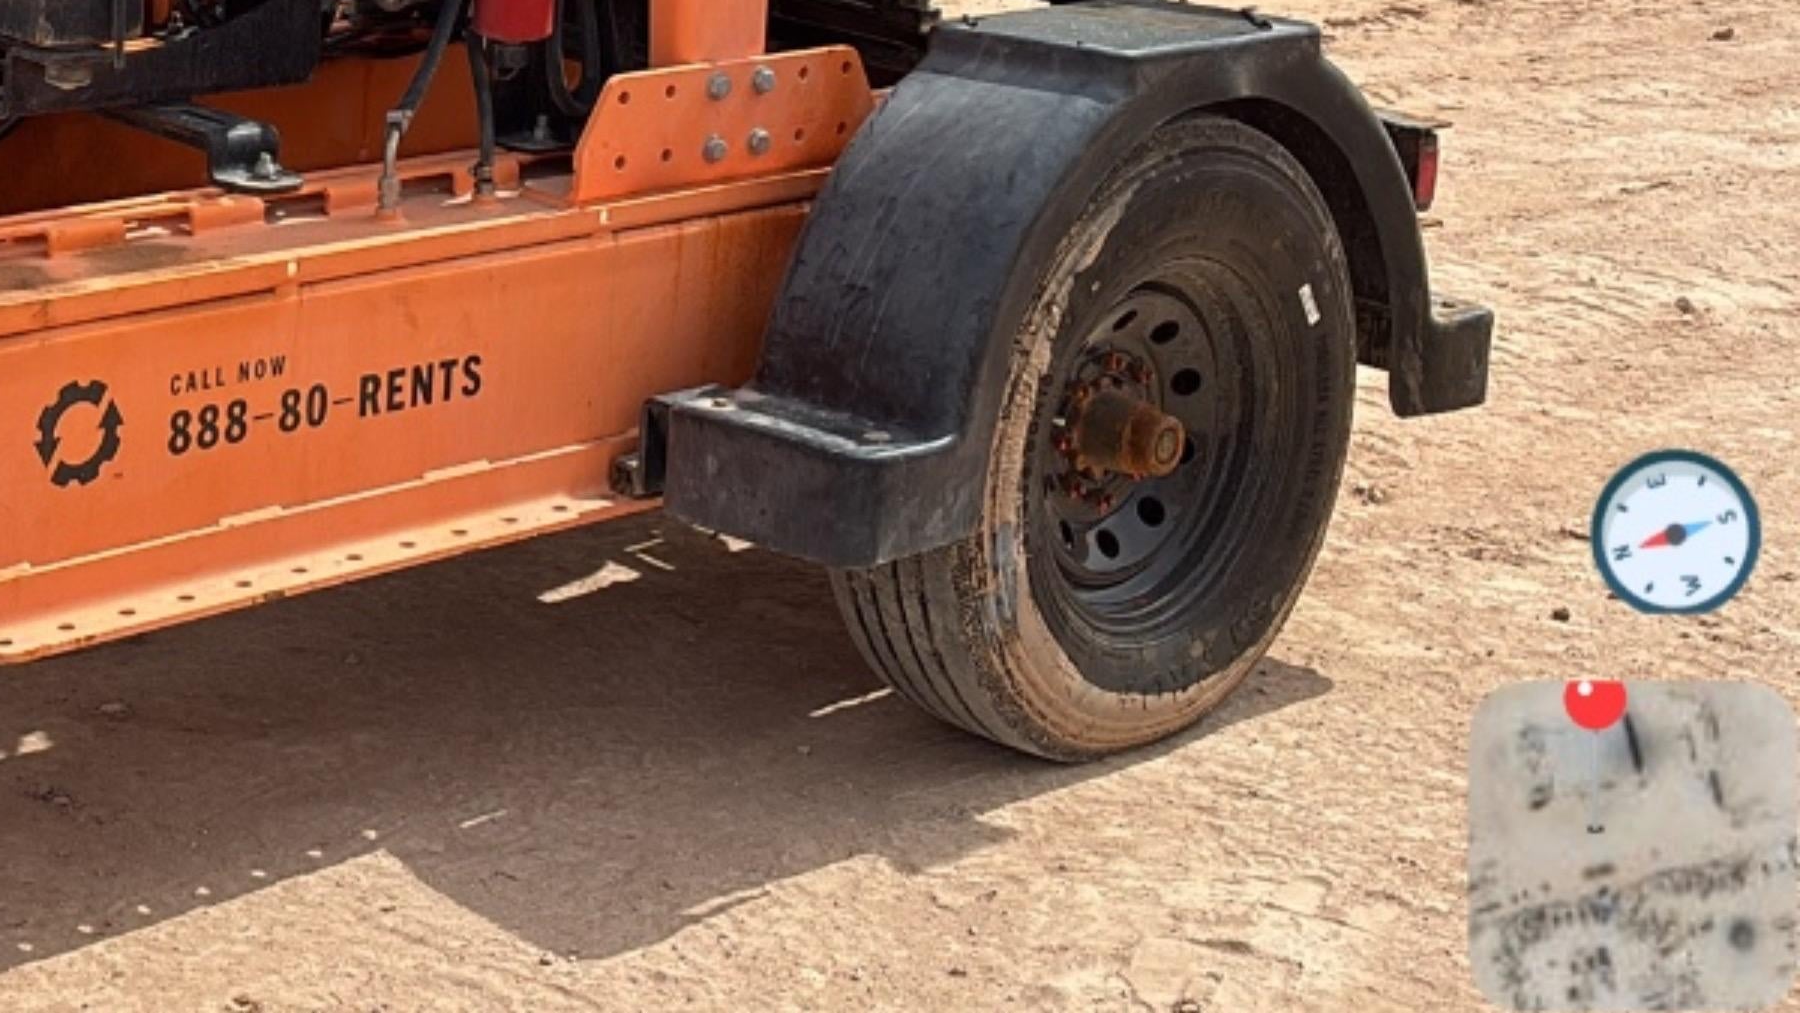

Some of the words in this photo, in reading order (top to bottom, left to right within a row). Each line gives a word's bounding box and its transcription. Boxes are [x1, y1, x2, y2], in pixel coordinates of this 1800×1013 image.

[167, 353, 483, 456] 888-80-RENTS
[169, 366, 227, 397] CALL
[237, 354, 288, 383] NOW
